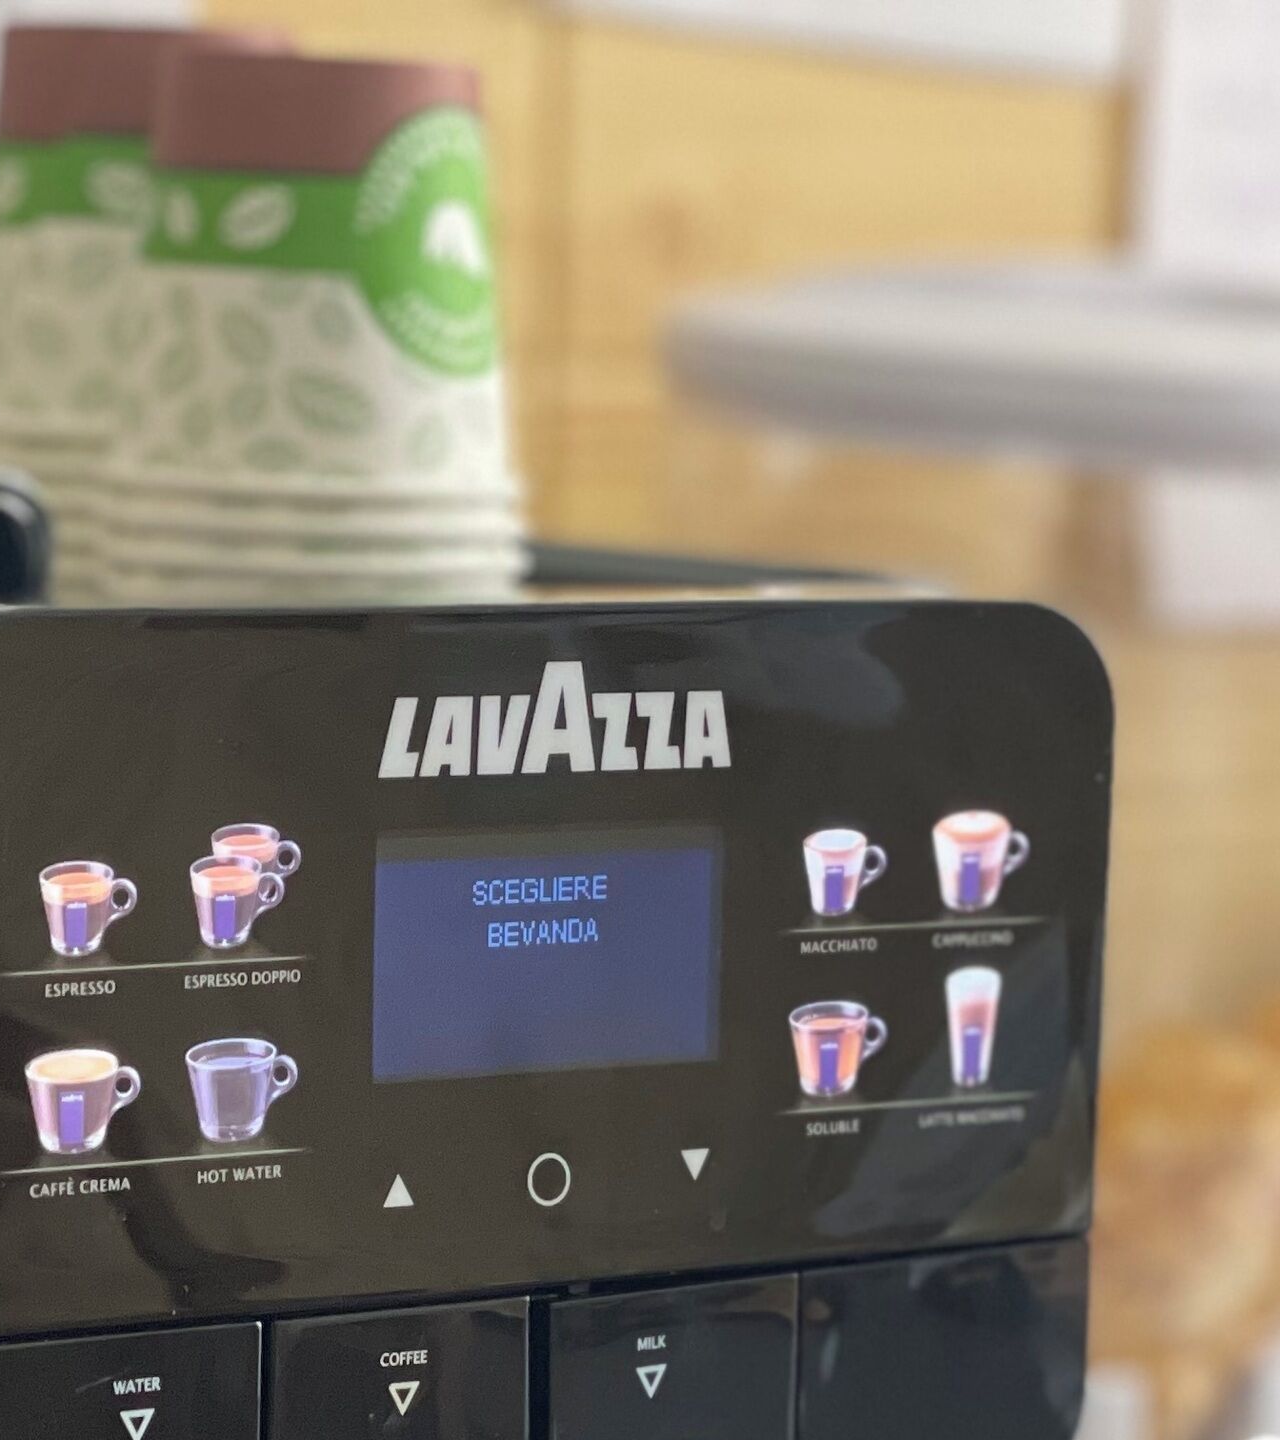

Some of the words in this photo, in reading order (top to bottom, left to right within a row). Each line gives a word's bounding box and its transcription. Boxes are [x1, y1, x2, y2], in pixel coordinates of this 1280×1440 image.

[378, 661, 731, 778] LAVAZZA
[472, 875, 608, 906] SCEGLIERE
[487, 918, 599, 948] BEVANDA
[800, 937, 878, 954] MACCHIATO
[184, 972, 248, 989] ESPRESSO
[251, 969, 301, 985] DOPPIO
[45, 980, 116, 998] ESPRESSO
[806, 1119, 860, 1136] SOLUBLE
[197, 1168, 228, 1184] HOT
[232, 1164, 282, 1181] WATER
[29, 1176, 75, 1199] CAFFÈ
[79, 1177, 131, 1194] CREMA
[637, 1334, 667, 1352] MILK
[380, 1349, 428, 1367] COFFEE
[113, 1376, 161, 1395] WATER
